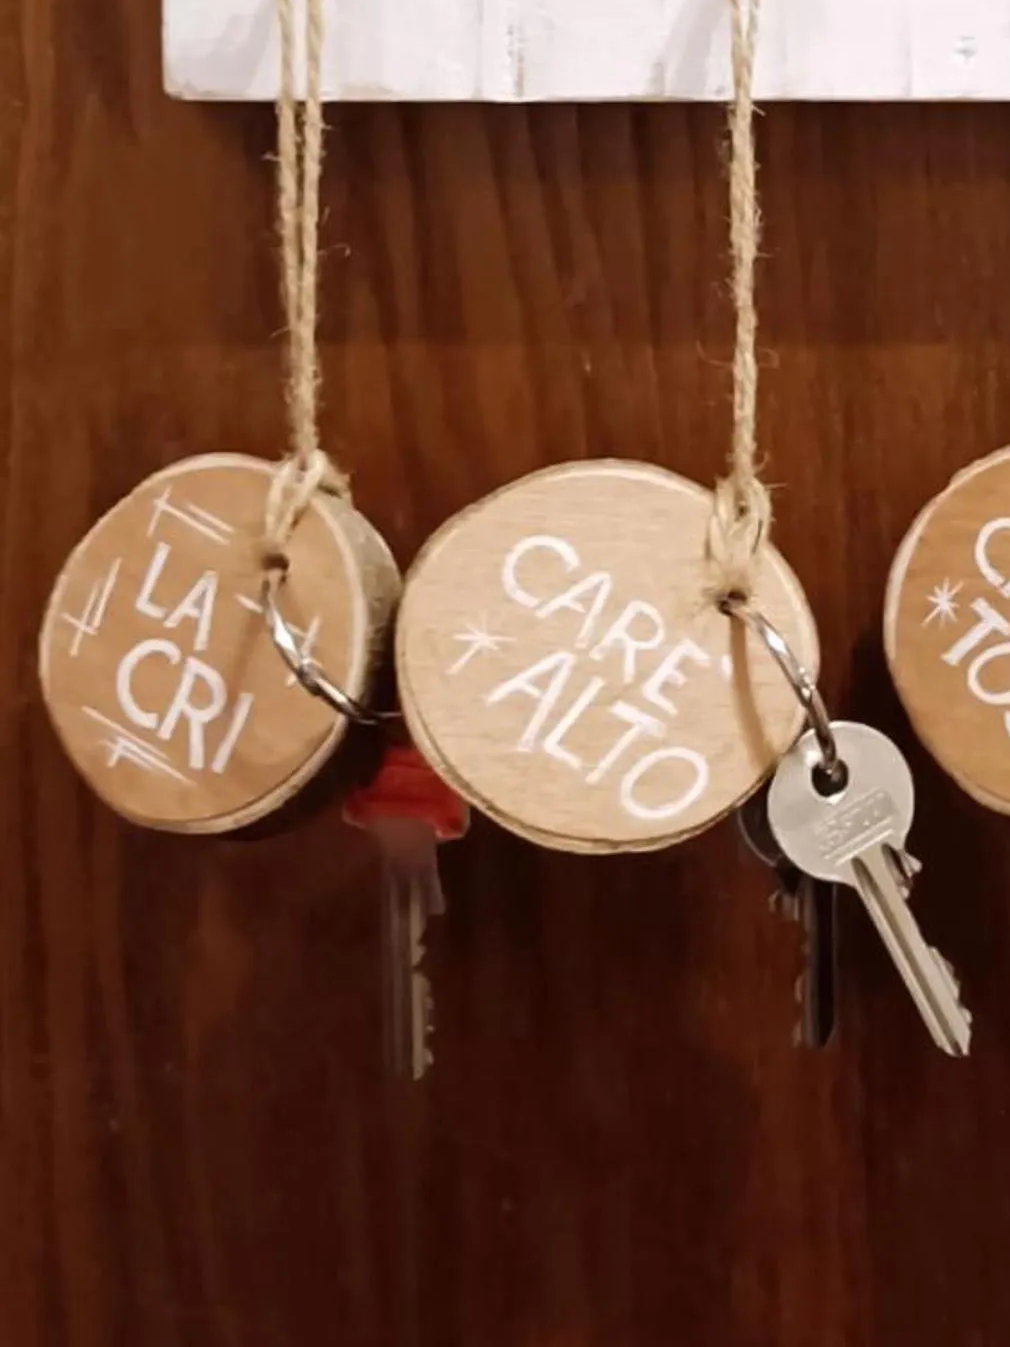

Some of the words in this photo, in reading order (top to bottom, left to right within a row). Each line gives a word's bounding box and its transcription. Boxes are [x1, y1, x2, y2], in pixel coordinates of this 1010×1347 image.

[135, 541, 219, 651] LA
[116, 638, 254, 773] CRI
[483, 651, 709, 820] ALTO
